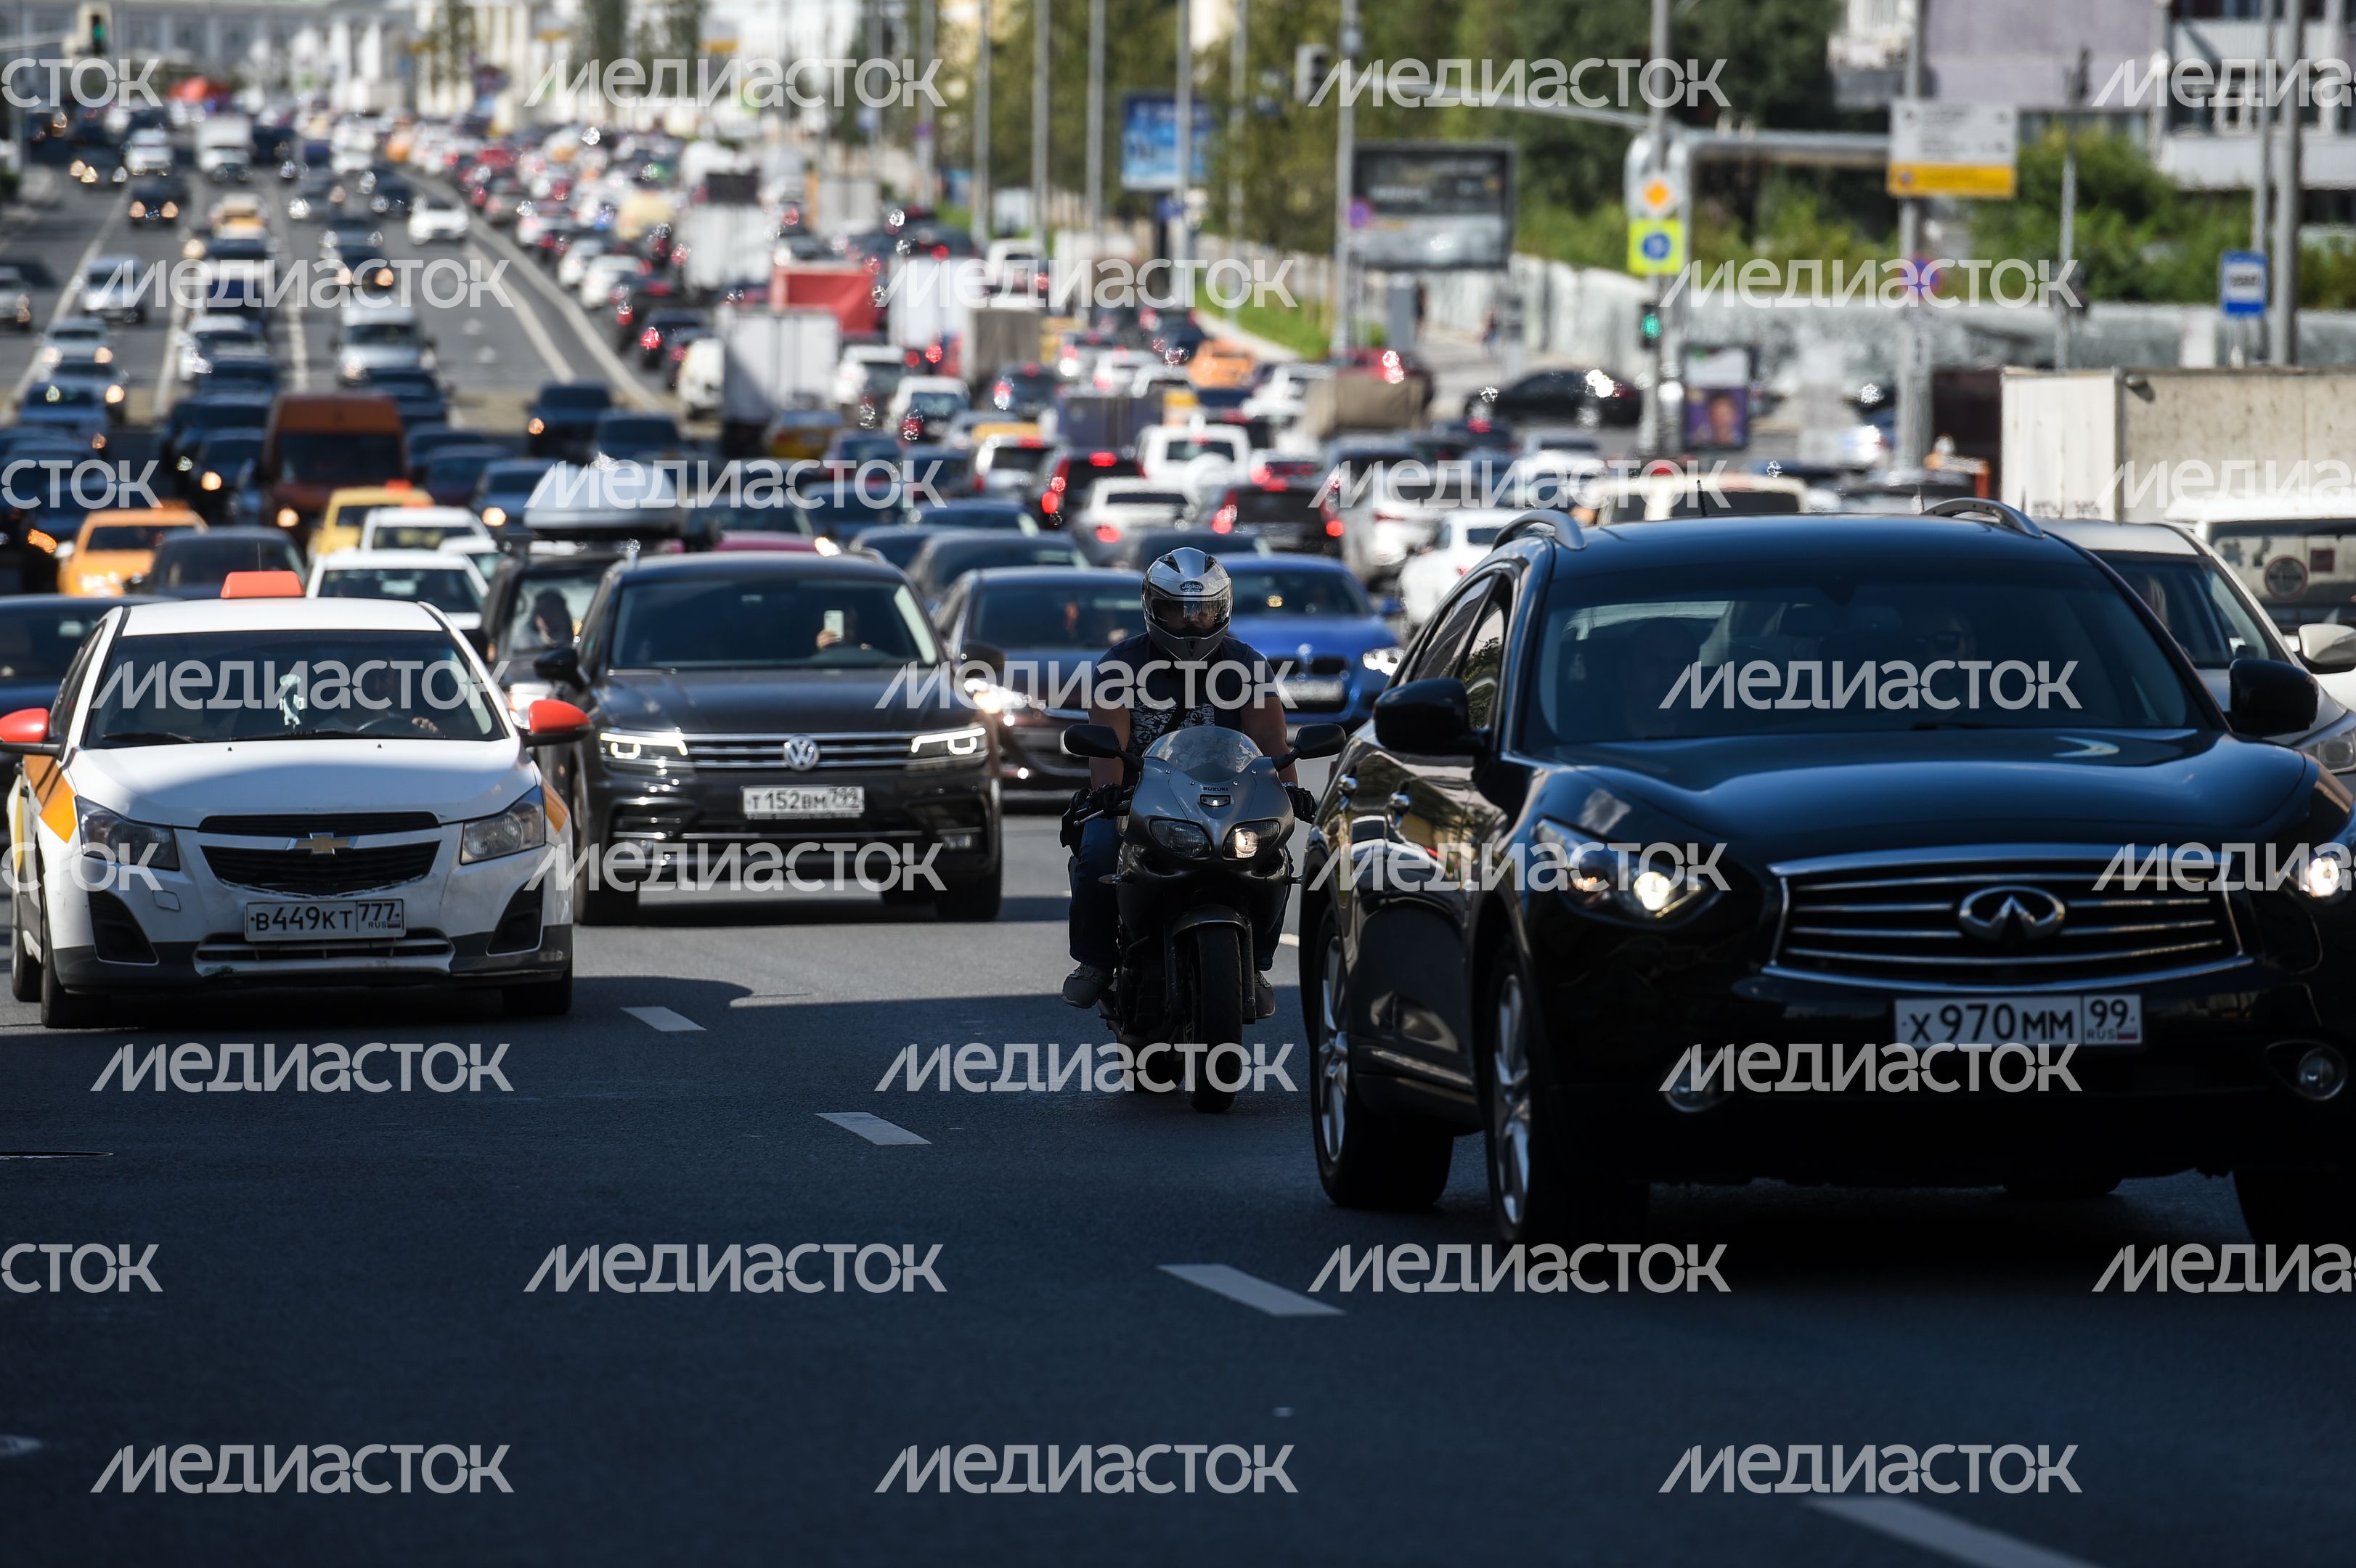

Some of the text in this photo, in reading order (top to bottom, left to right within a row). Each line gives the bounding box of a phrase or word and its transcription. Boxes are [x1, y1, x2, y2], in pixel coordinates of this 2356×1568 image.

[256, 902, 396, 931] В449КТ 777
[367, 920, 387, 929] RUS
[2089, 999, 2129, 1028] 99
[2086, 1029, 2116, 1041] RUS
